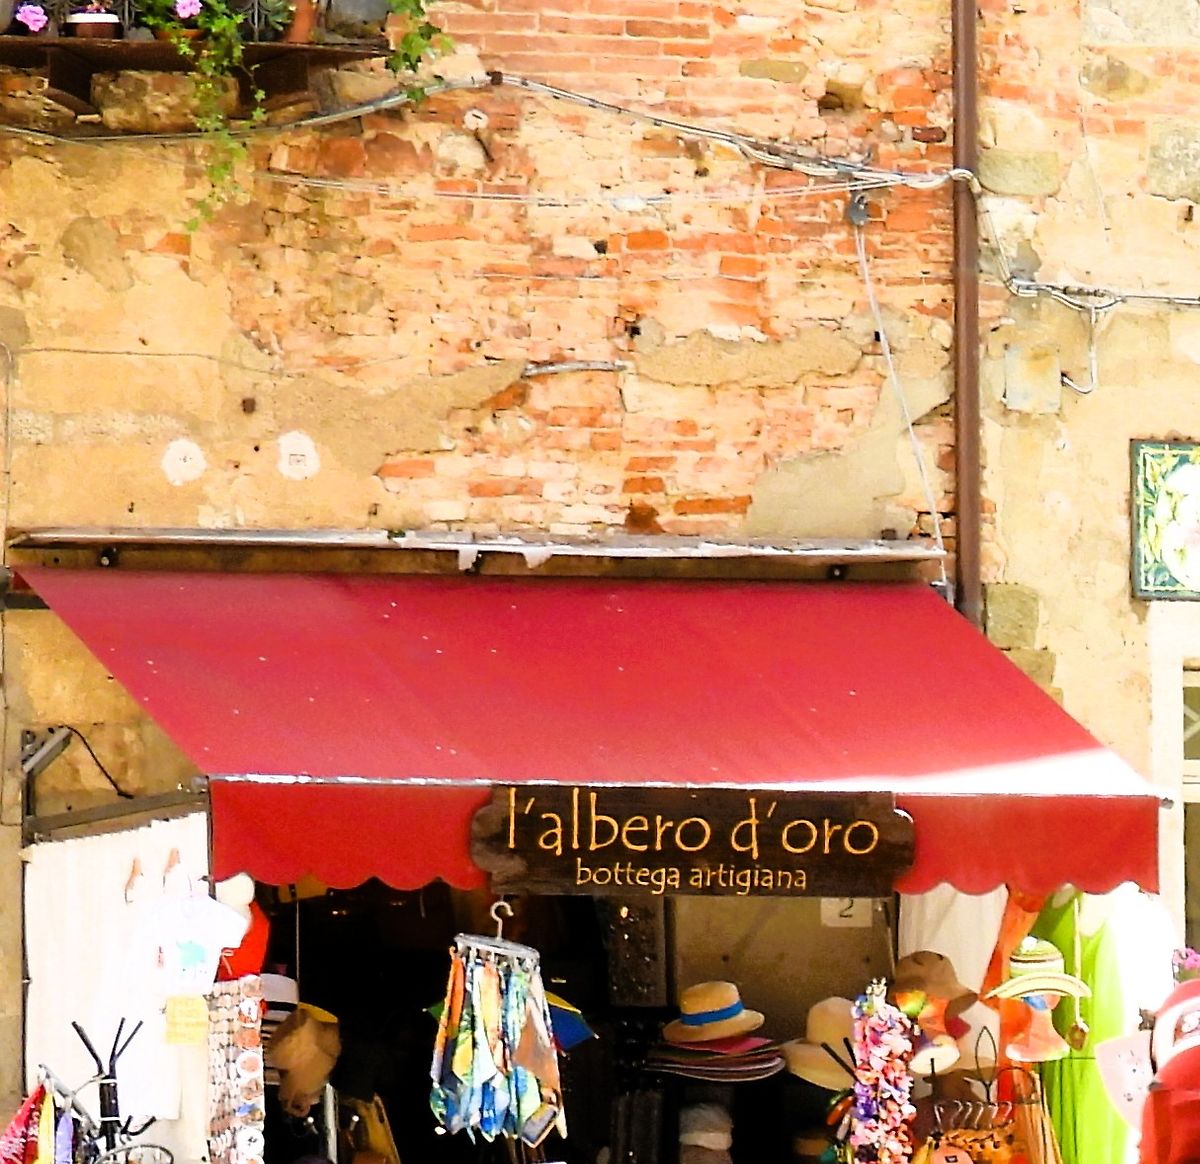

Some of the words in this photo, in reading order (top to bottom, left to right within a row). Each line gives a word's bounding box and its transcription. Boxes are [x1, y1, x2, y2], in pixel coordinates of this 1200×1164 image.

[506, 786, 712, 856] l'albero
[730, 797, 879, 860] d'oro
[575, 858, 681, 895] bottega
[688, 862, 807, 896] artigiana
[838, 896, 854, 918] 2
